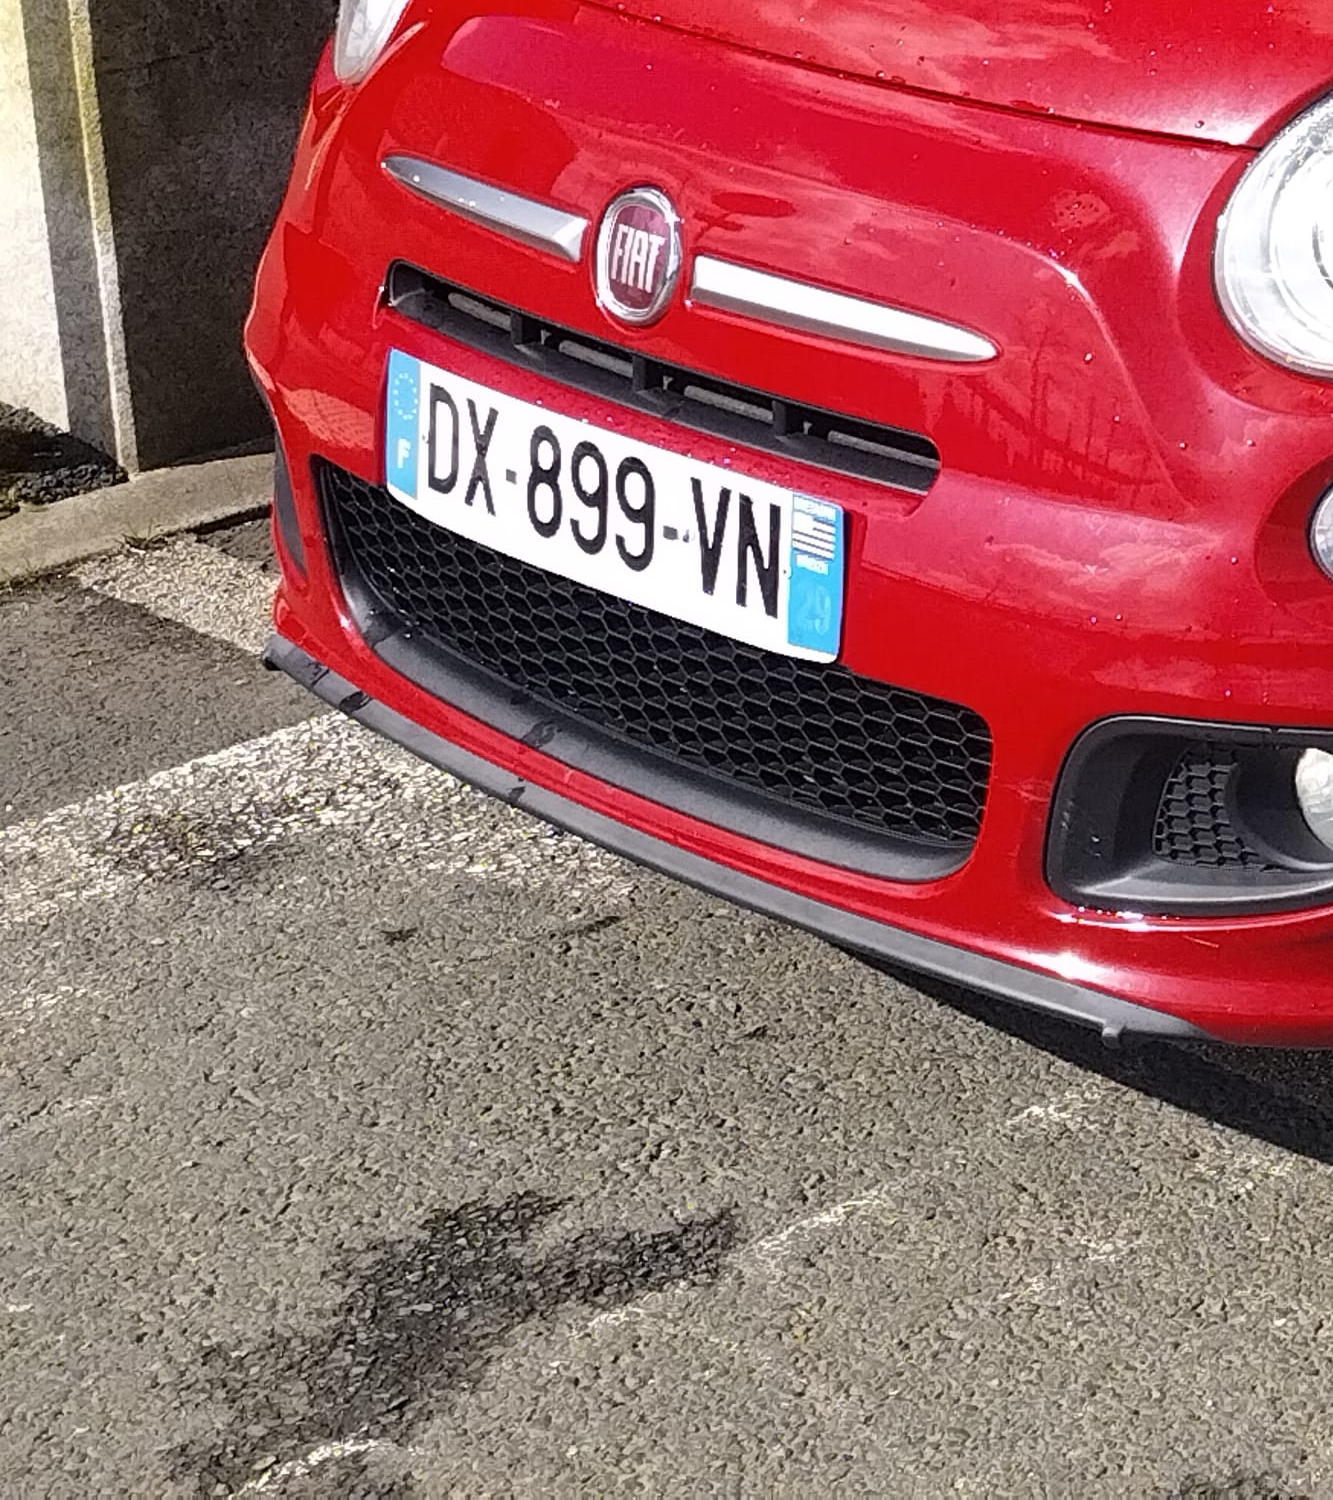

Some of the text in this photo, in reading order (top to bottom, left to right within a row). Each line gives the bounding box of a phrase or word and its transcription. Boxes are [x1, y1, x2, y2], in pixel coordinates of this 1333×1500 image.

[611, 223, 666, 293] FIAT
[397, 438, 411, 469] F
[428, 382, 781, 618] DX-899-VN
